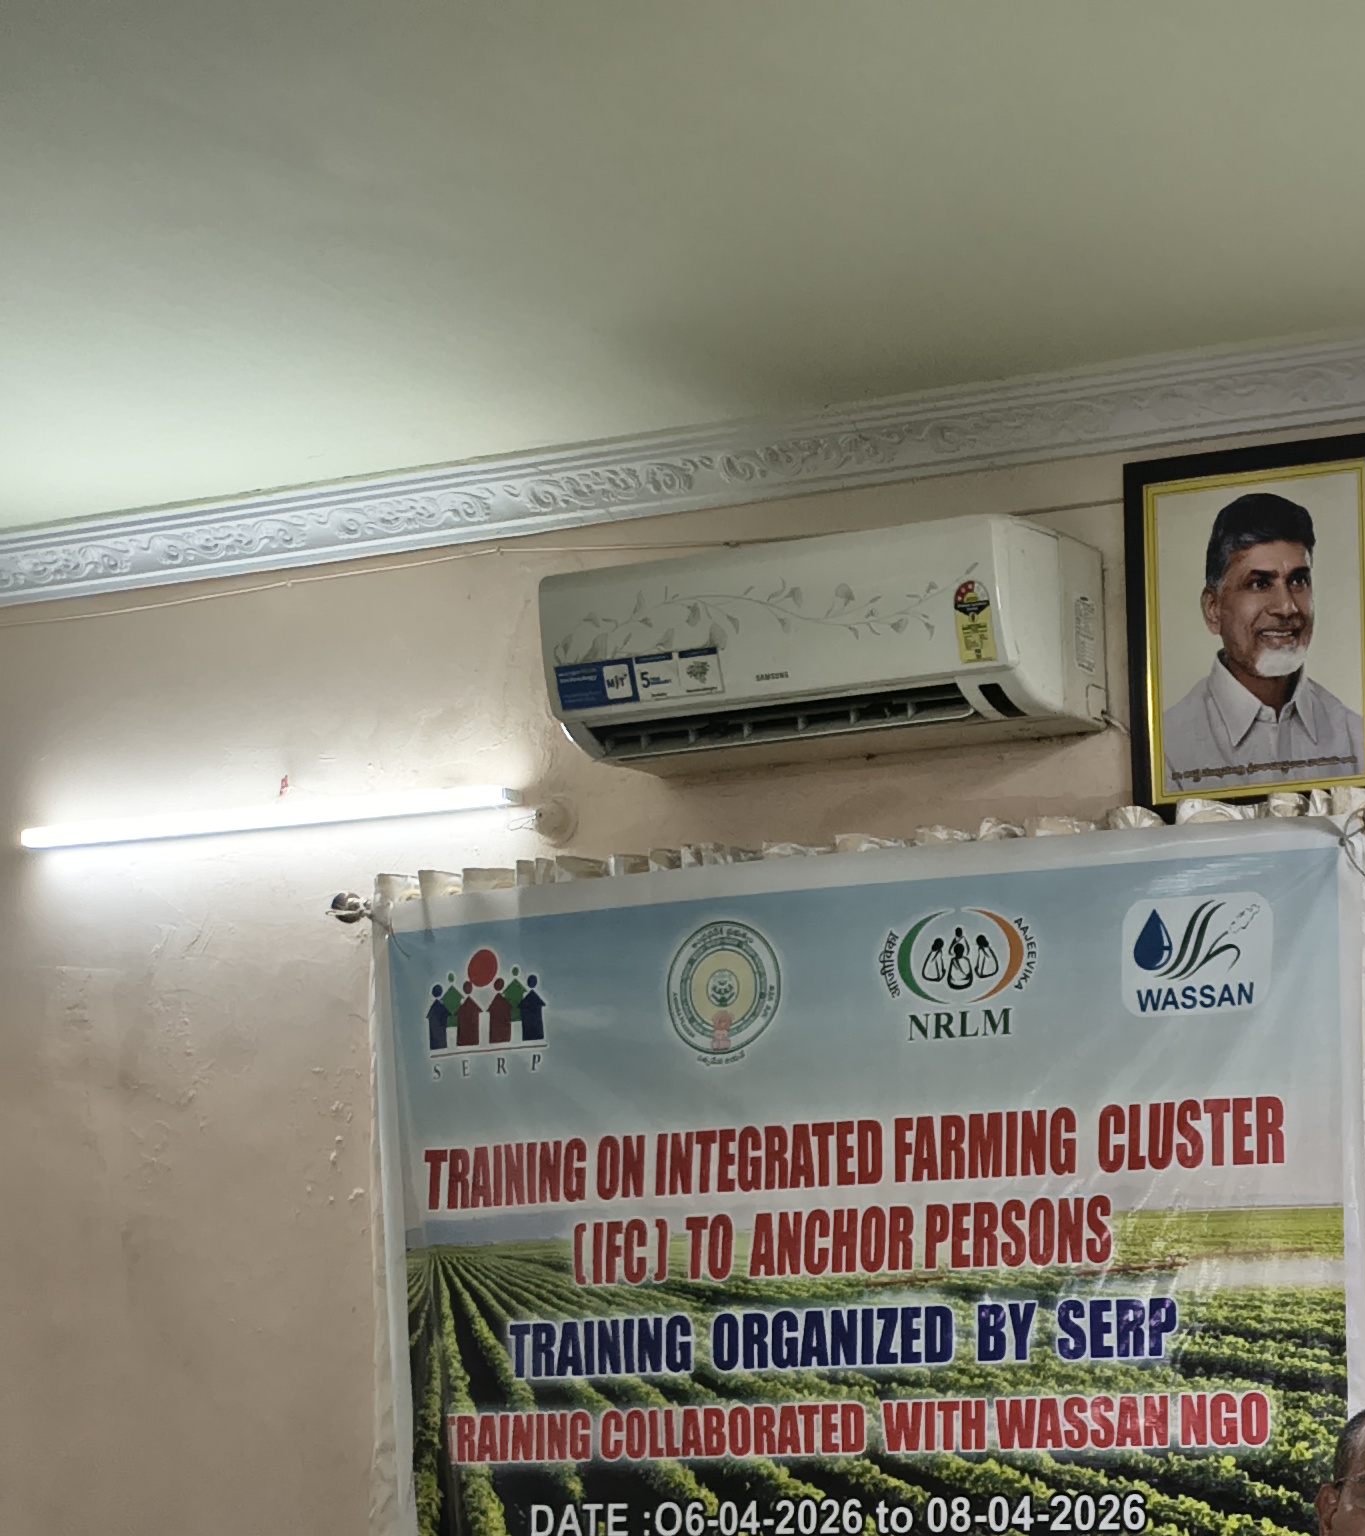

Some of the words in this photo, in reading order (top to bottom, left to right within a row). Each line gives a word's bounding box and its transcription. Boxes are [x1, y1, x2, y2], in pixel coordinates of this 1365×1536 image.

[755, 670, 789, 683] SAMSUNG
[1014, 917, 1037, 991] AAJEEVIKA
[906, 1007, 1013, 1042] NRLM
[1137, 983, 1255, 1013] WASSAN
[425, 1138, 587, 1210] TRAINING
[597, 1133, 646, 1200] ON
[655, 1119, 883, 1196] INTEGRATED
[894, 1107, 1077, 1183] FARMING
[1099, 1096, 1286, 1173] CLUSTER
[686, 1214, 734, 1280] TO
[748, 1205, 913, 1278] ANCHOR
[924, 1195, 1112, 1270] PERSONS
[509, 1315, 693, 1378] TRAINING
[713, 1305, 954, 1371] ORGANIZED
[976, 1302, 1037, 1362] BY
[1057, 1298, 1178, 1360] SERP
[599, 1402, 866, 1461] COLLABORATED
[882, 1399, 986, 1452] WITH
[995, 1395, 1170, 1450] WASSAN
[1181, 1391, 1269, 1447] NGO
[876, 1497, 914, 1534] to
[927, 1493, 1146, 1532] 08-04-2026
